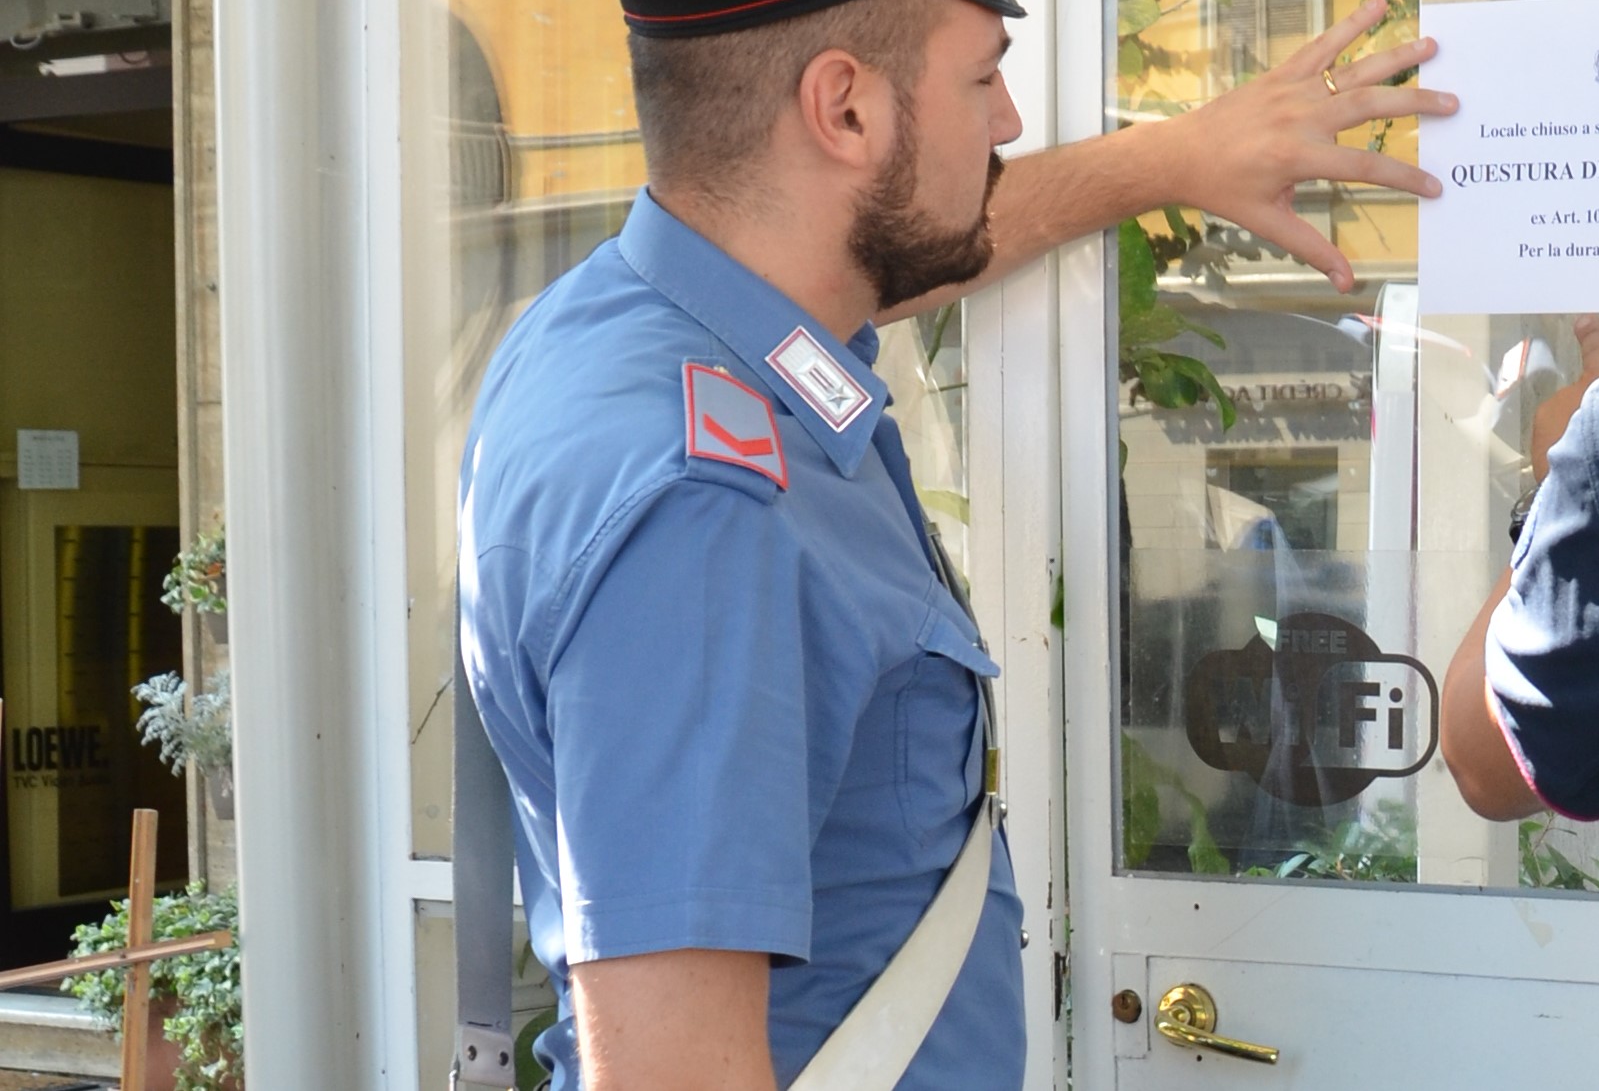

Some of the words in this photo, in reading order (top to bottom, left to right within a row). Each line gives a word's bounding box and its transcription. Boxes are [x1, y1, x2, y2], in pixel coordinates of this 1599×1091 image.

[1480, 123, 1527, 139] Locale
[1531, 121, 1578, 137] chiuso
[1581, 124, 1591, 135] a
[1451, 161, 1574, 188] QUESTURA
[1530, 213, 1547, 225] ex
[1551, 210, 1581, 224] Art.
[1519, 243, 1544, 258] Per
[1548, 242, 1561, 257] la
[1276, 629, 1348, 655] FREE
